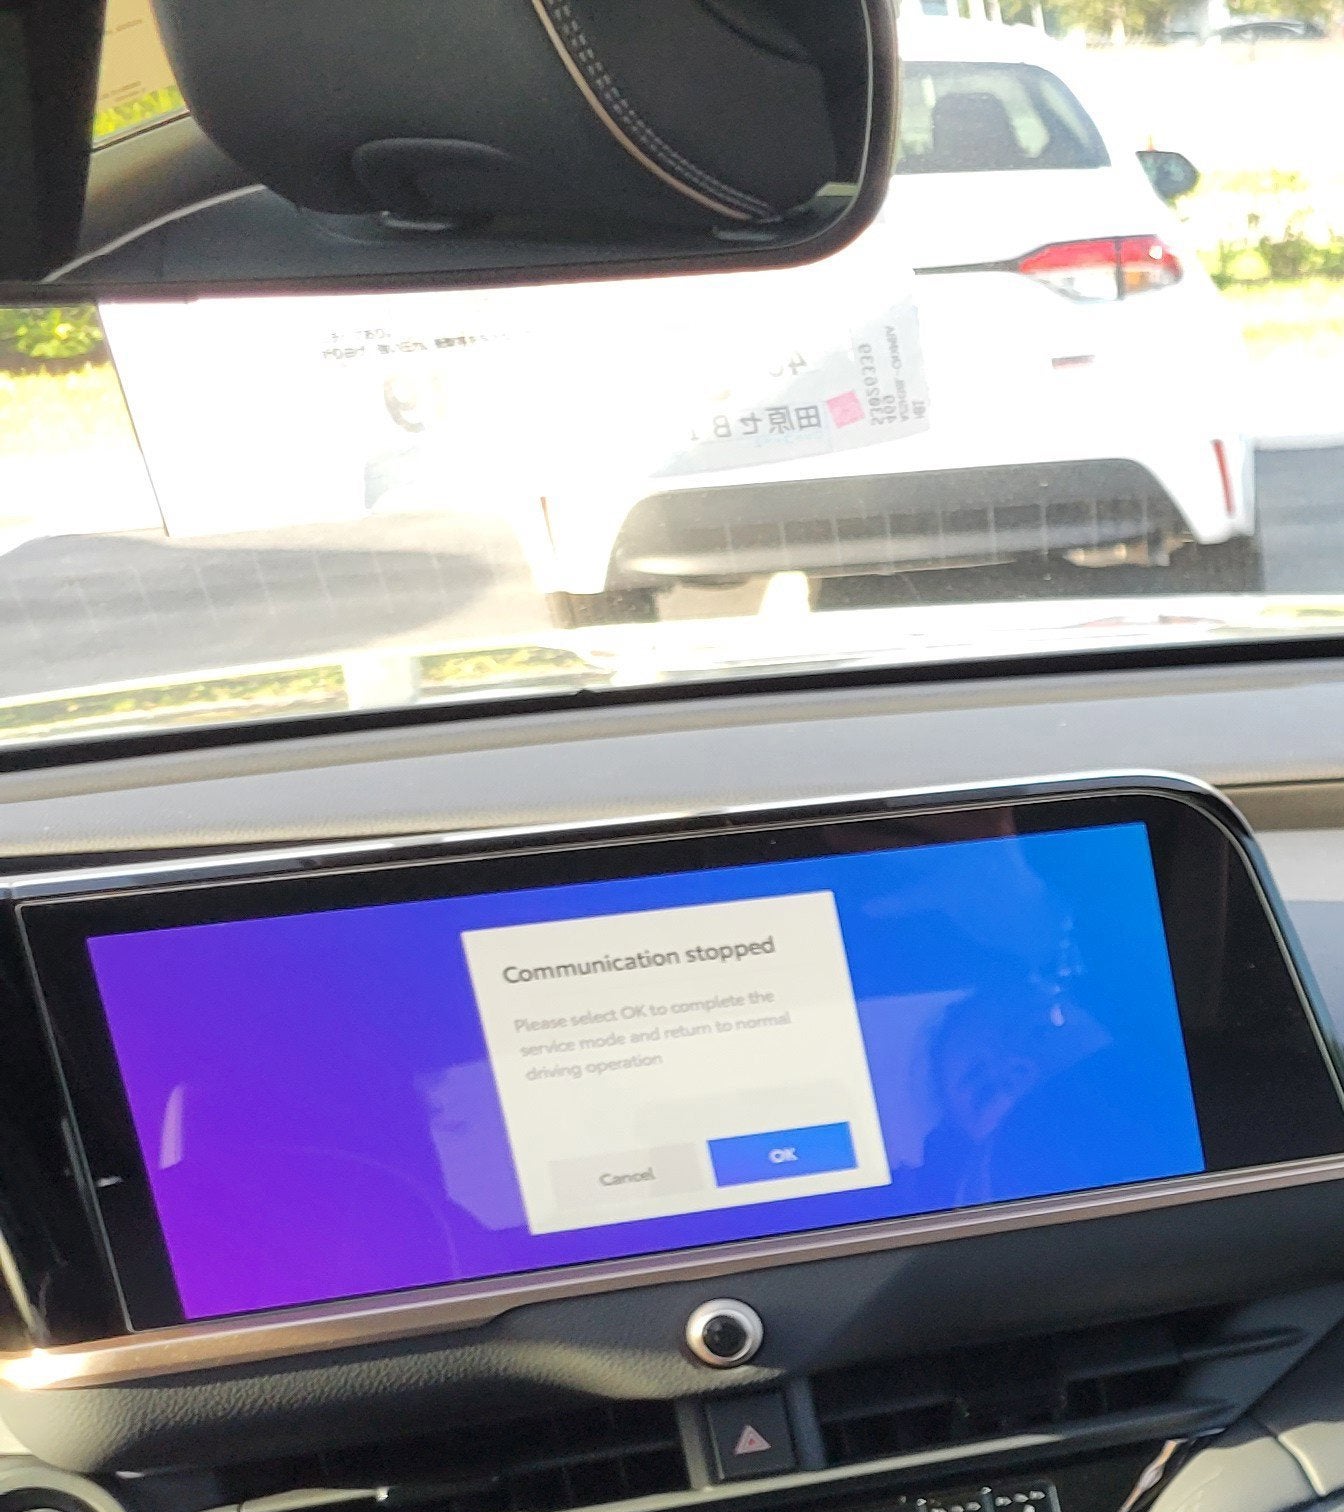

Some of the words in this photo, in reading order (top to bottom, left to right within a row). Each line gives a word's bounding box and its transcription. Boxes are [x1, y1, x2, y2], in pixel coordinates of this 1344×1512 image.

[502, 950, 681, 984] Communication
[685, 935, 776, 962] stopped
[514, 1018, 568, 1033] Please
[570, 1009, 618, 1027] select
[620, 1004, 648, 1020] OK
[649, 1003, 668, 1016] to
[670, 995, 745, 1013] complete
[748, 990, 776, 1005] the
[520, 1039, 576, 1057] service
[579, 1031, 627, 1050] mode
[630, 1026, 661, 1043] and
[664, 1025, 713, 1039] return
[715, 1020, 733, 1033] to
[736, 1011, 793, 1031] normal
[525, 1065, 584, 1082] driving
[767, 1145, 798, 1164] OK
[599, 1166, 656, 1187] Cancel
